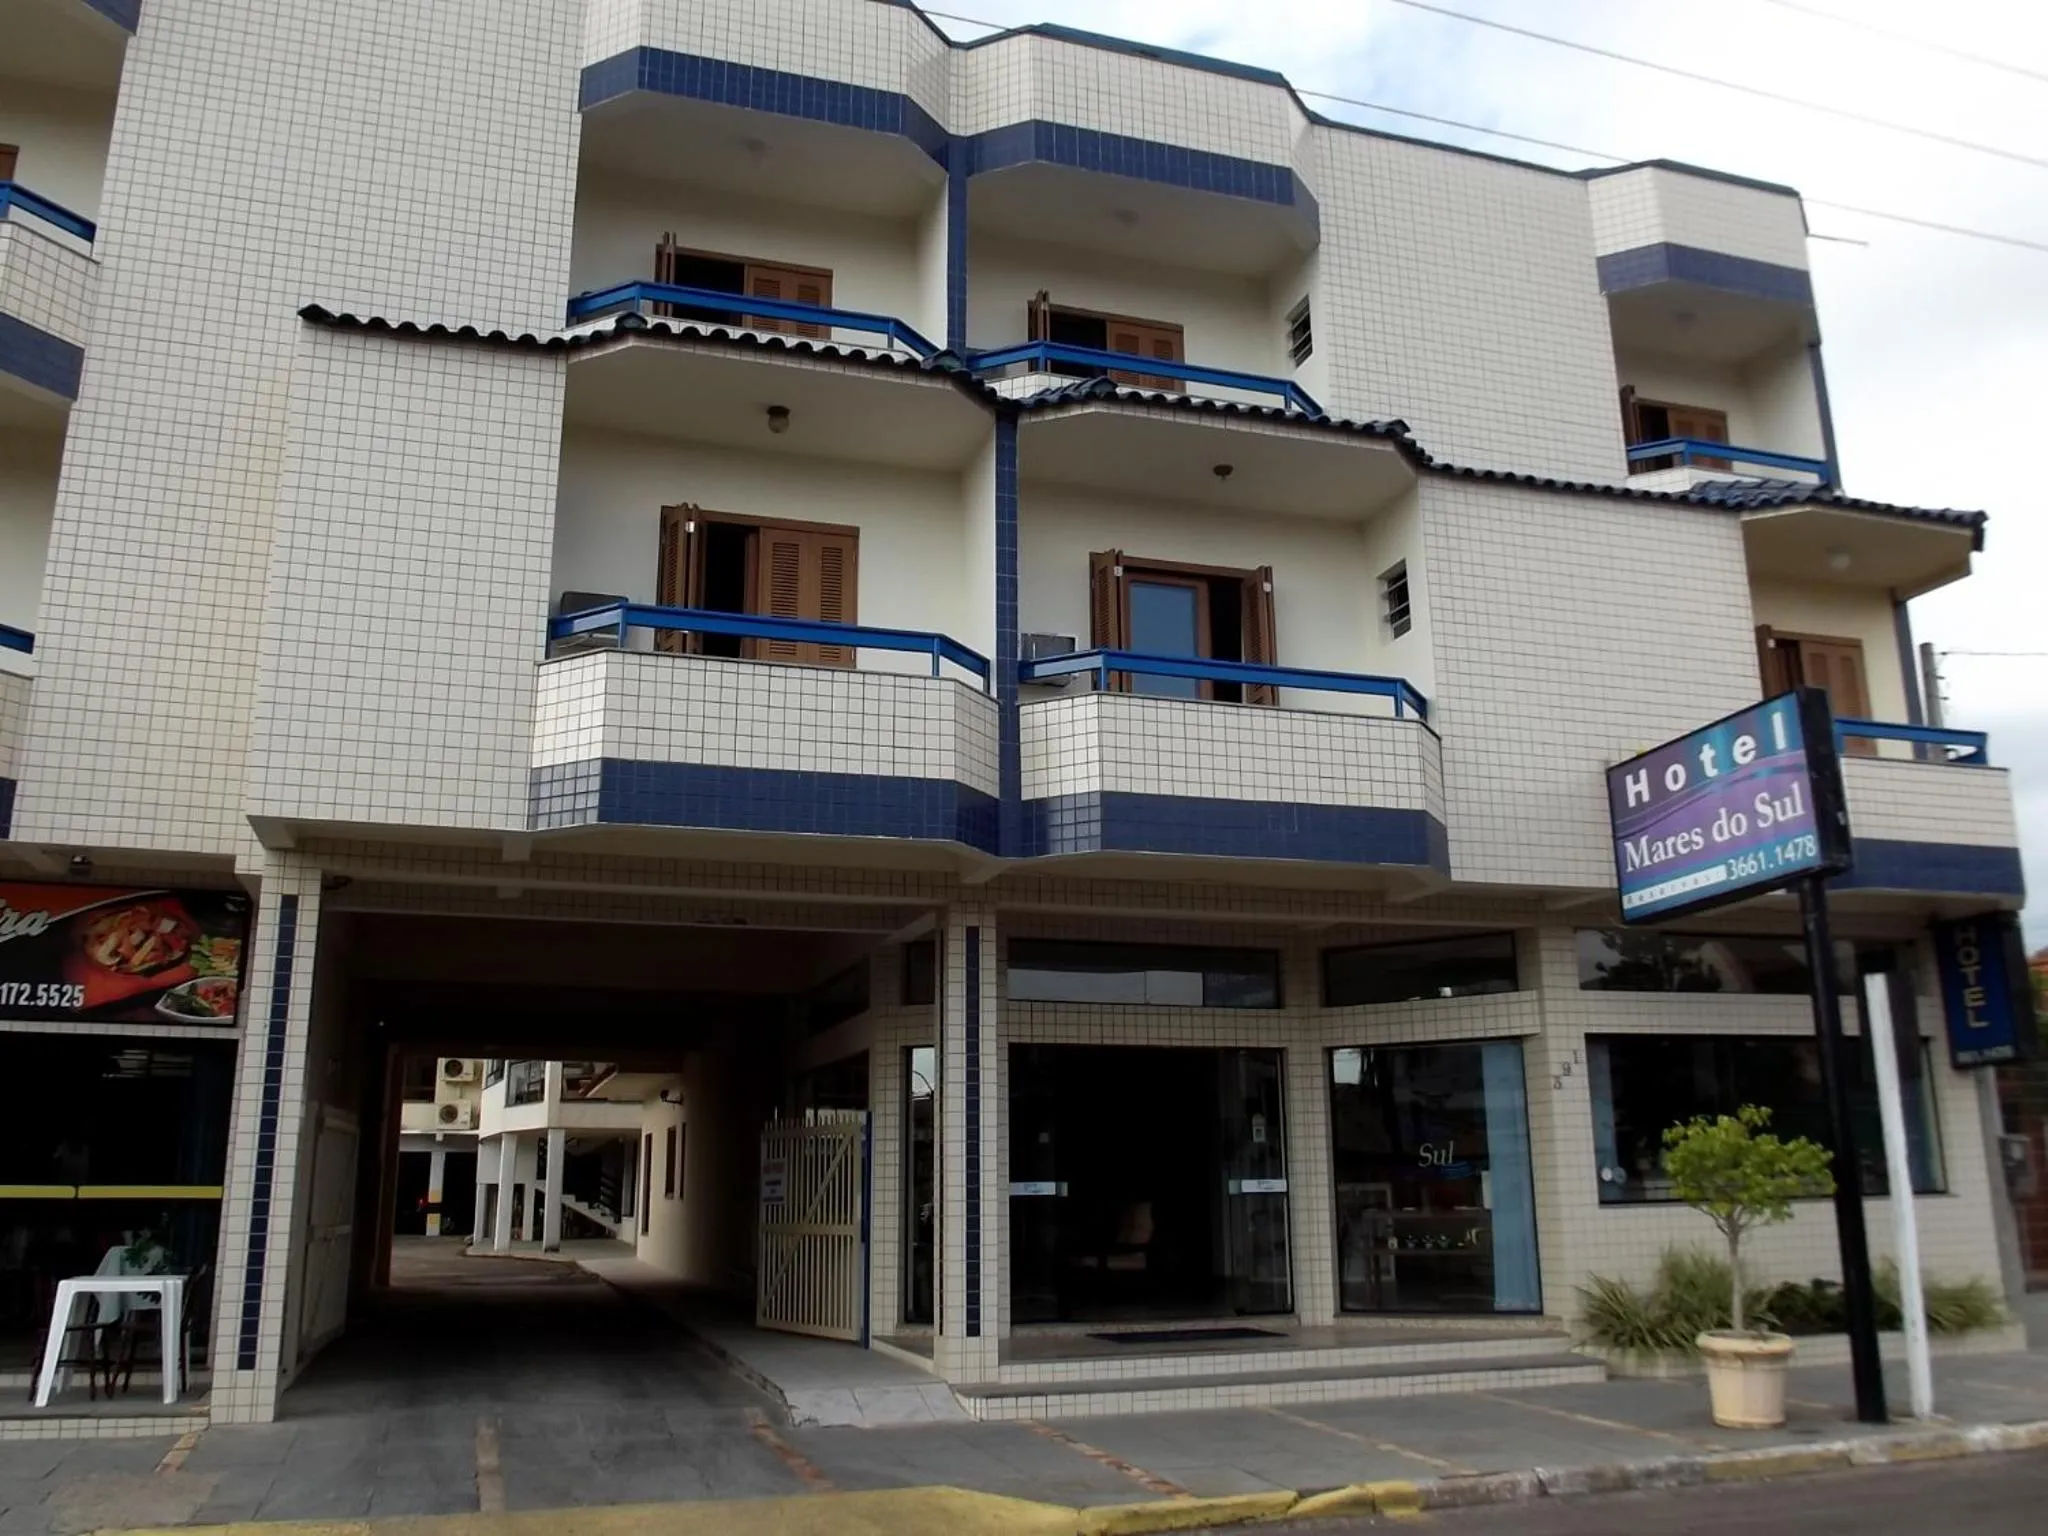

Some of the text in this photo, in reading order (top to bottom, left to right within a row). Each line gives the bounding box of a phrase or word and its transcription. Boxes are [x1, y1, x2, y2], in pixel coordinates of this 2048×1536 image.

[1624, 711, 1789, 808] Hotel
[1623, 782, 1806, 873] Mares do Sul
[1725, 833, 1817, 881] 3661.1478
[1952, 924, 1992, 1029] HOTEL
[1416, 1139, 1456, 1168] Sul
